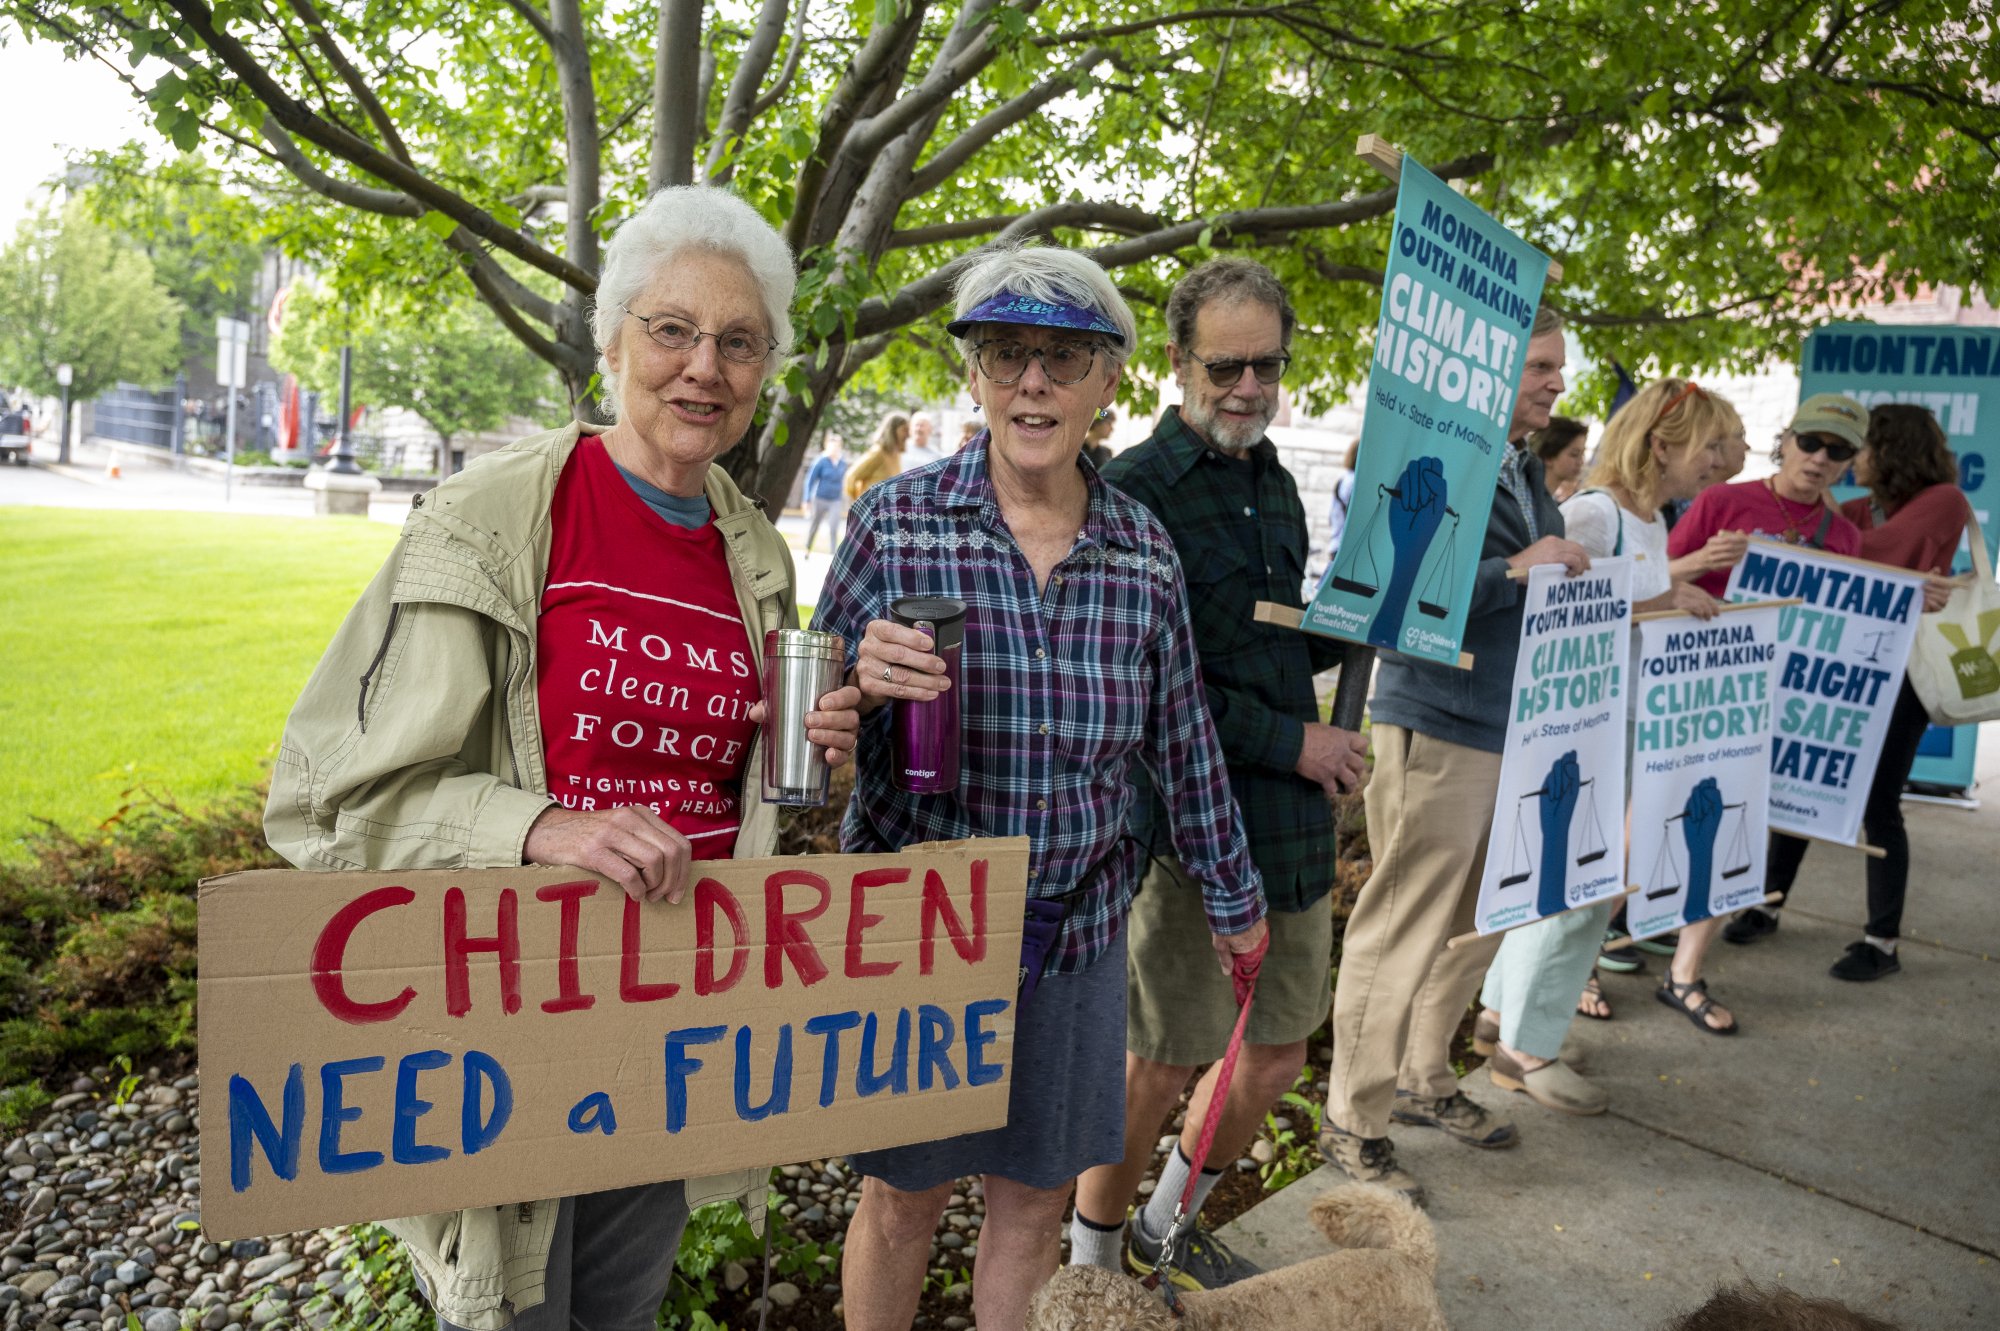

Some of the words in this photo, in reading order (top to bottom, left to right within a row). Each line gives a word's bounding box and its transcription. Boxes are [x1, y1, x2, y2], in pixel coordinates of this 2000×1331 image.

[1421, 199, 1518, 285] MONTANA
[1456, 264, 1532, 329] MAKING
[1376, 316, 1513, 429] HISTORY!
[1375, 385, 1396, 411] Held
[1409, 404, 1434, 430] State
[1437, 420, 1454, 435] of
[1546, 578, 1613, 607] MONTANA
[1738, 552, 1915, 625] MONTANA
[1525, 611, 1567, 637] YOUTH
[1572, 599, 1627, 627] MAKING
[1665, 624, 1754, 652] MONTANA
[586, 619, 750, 678] MOMS
[1705, 643, 1775, 669] MAKING
[580, 659, 689, 711] clean
[707, 689, 756, 721] air
[1646, 670, 1767, 716] CLIMATE
[1780, 650, 1891, 706] RIGHT
[570, 712, 742, 765] FORCE
[1541, 721, 1570, 737] State
[1637, 702, 1769, 751] HISTORY!
[1779, 697, 1870, 748] SAFE
[569, 775, 681, 794] FIGHTING
[688, 780, 718, 795] FO
[905, 769, 935, 779] contigo
[1646, 759, 1674, 773] Held
[1708, 750, 1721, 761] of
[310, 859, 989, 1025] CHILDREN
[228, 1050, 514, 1192] NEED
[567, 1091, 617, 1136] a
[664, 999, 1011, 1134] FUTURE
